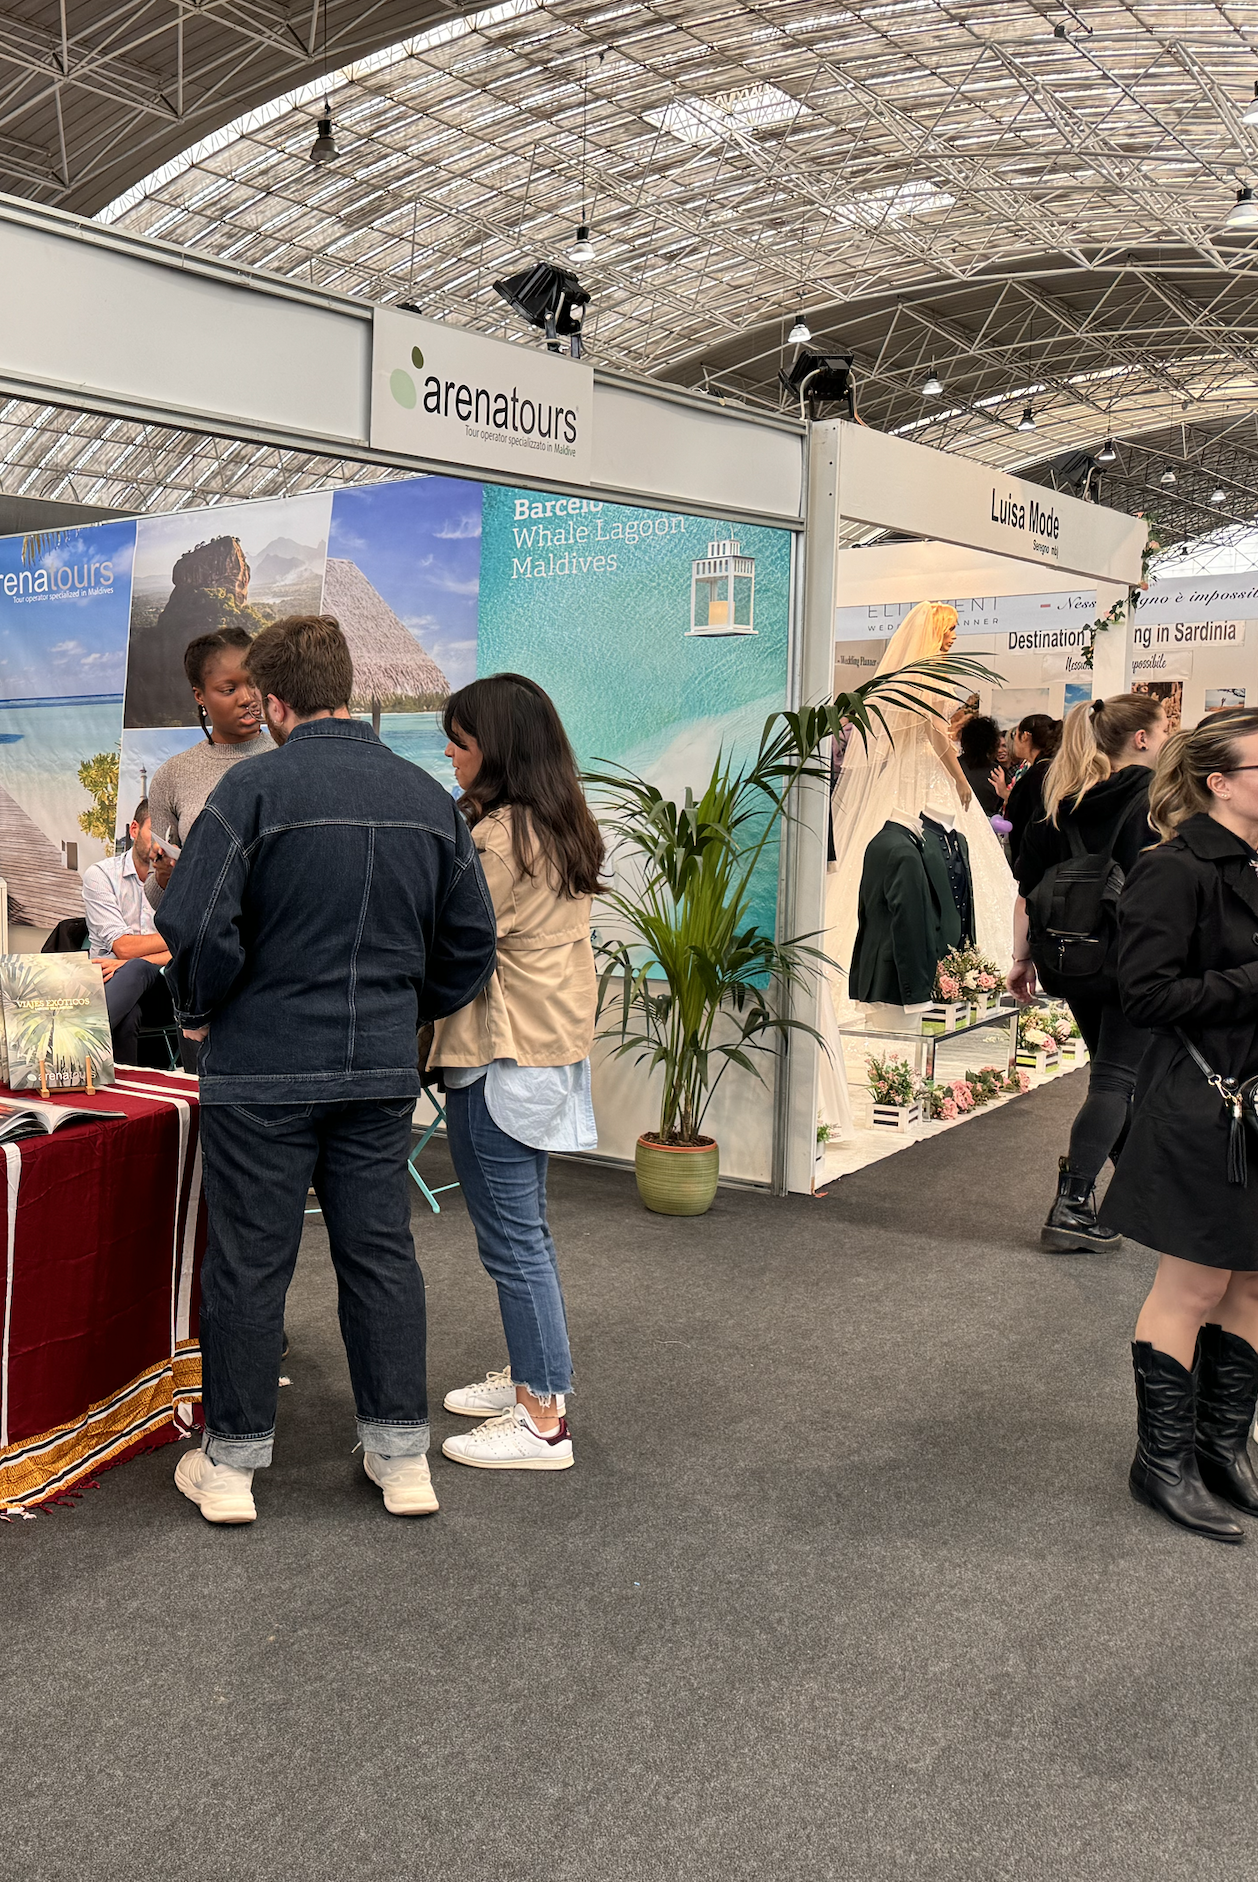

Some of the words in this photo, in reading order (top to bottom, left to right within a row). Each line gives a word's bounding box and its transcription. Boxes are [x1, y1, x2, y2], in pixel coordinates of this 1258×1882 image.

[423, 375, 577, 444] arenatours
[465, 424, 480, 438] Tour
[480, 429, 507, 443] operator
[508, 435, 546, 451] specializzato
[547, 441, 553, 452] in
[553, 443, 576, 457] Maldive
[991, 487, 1025, 530] Luisa
[1029, 500, 1060, 540] Mode
[512, 522, 590, 548] Whale
[595, 515, 686, 545] Lagoon
[510, 552, 618, 580] Maldives
[13, 595, 25, 603] Tour
[25, 593, 49, 603] operator
[49, 588, 80, 601] specialized
[80, 588, 87, 597] in
[87, 586, 114, 595] Maldives
[1057, 596, 1097, 611] Ness
[1175, 591, 1186, 603] è
[1008, 629, 1085, 650] Destination
[1156, 623, 1170, 643] in
[1174, 621, 1236, 642] Sardinia
[16, 1000, 45, 1009] VIAJES
[46, 997, 91, 1007] EXÓTICOS
